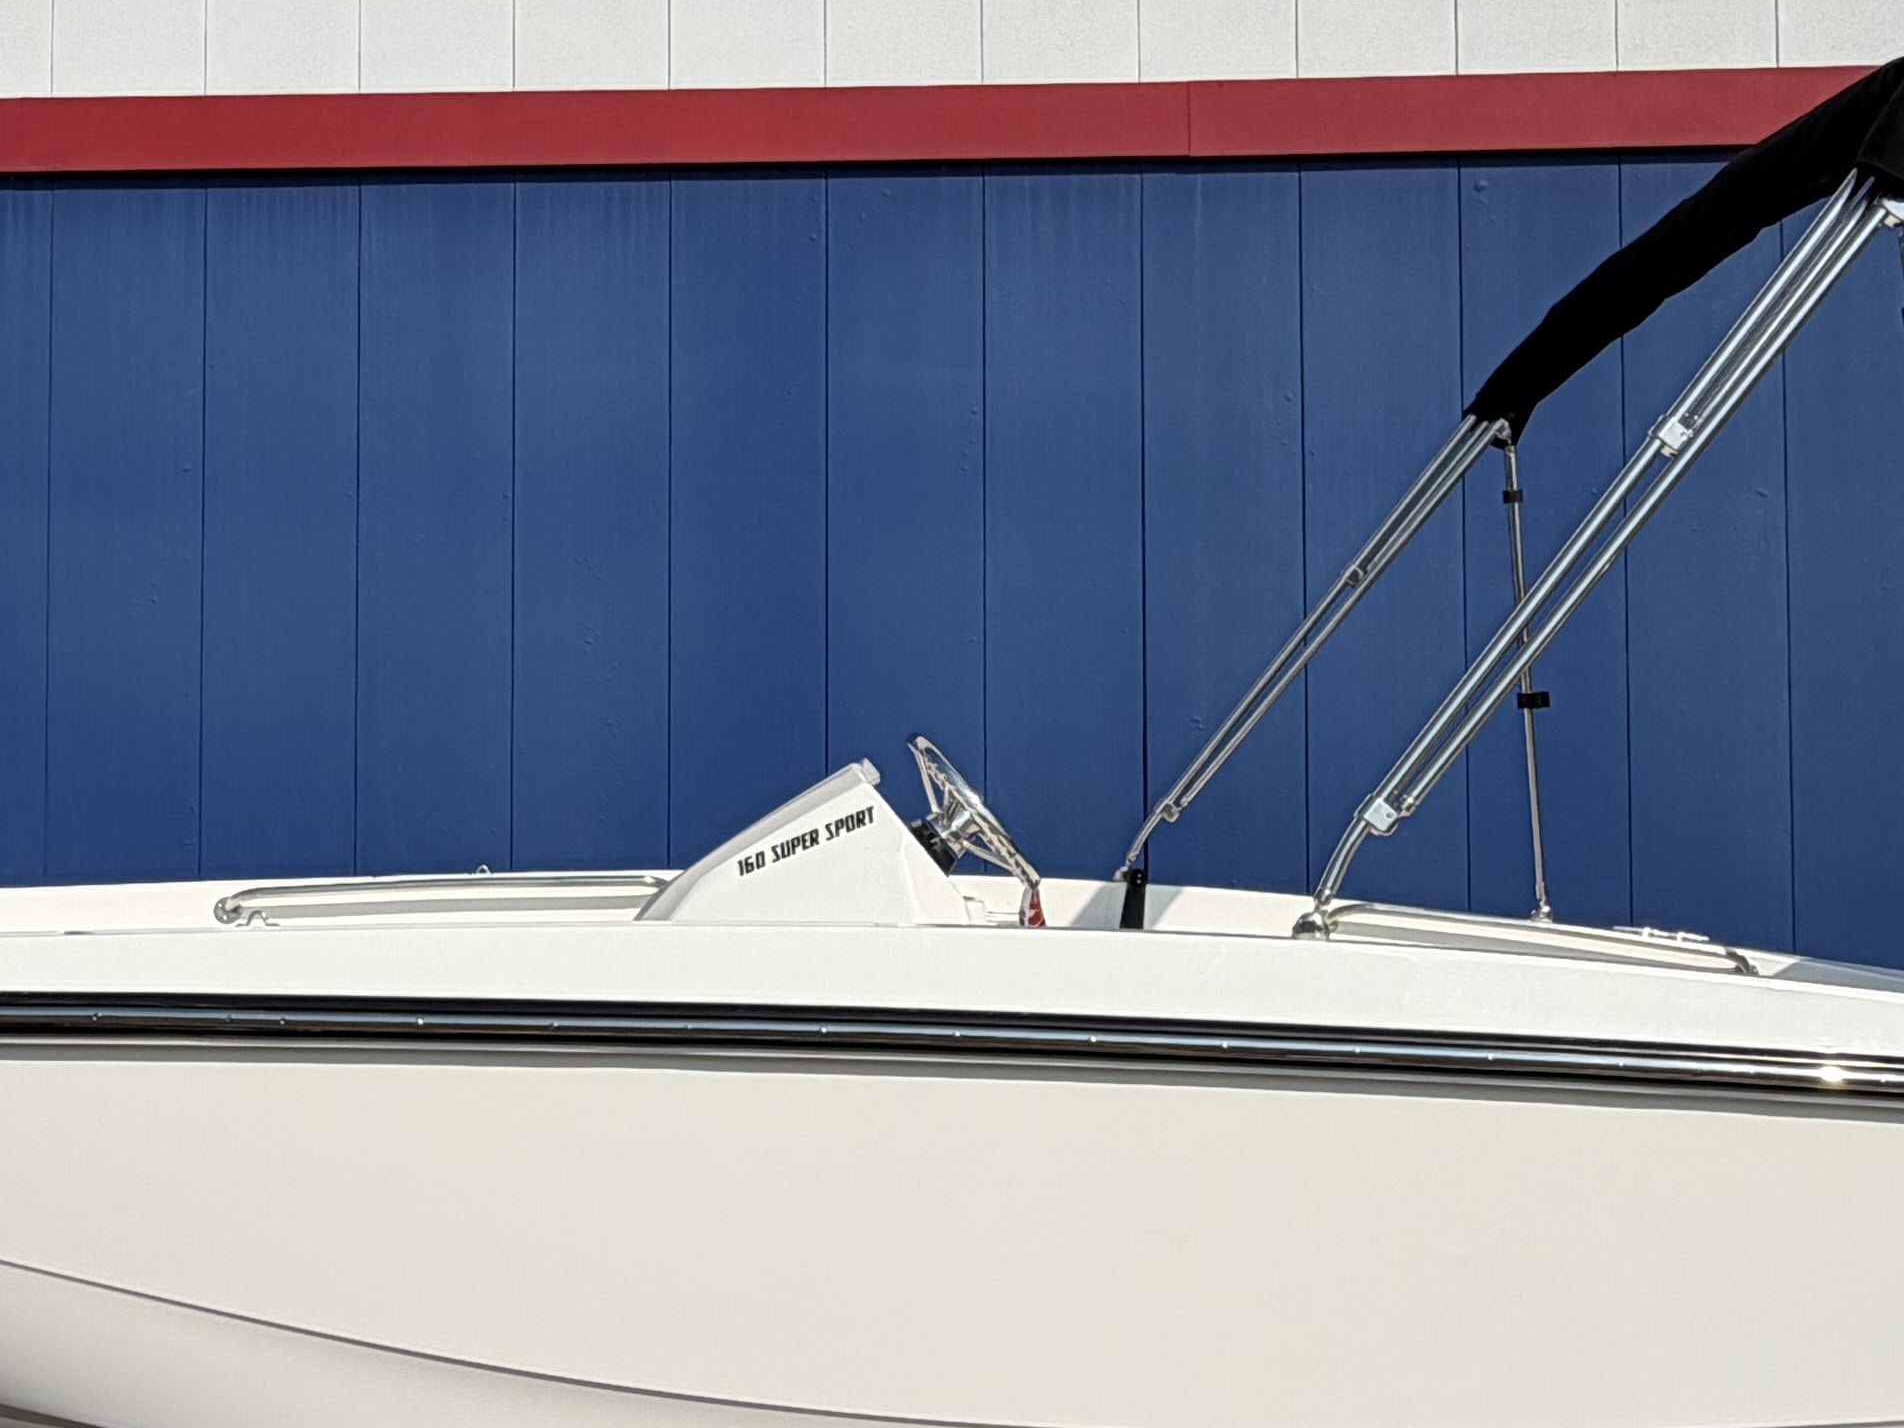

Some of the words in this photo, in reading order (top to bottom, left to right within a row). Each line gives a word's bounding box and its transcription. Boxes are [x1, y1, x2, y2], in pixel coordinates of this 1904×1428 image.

[737, 850, 766, 877] 160
[771, 827, 820, 863] SUPER
[824, 805, 874, 841] SPORT
